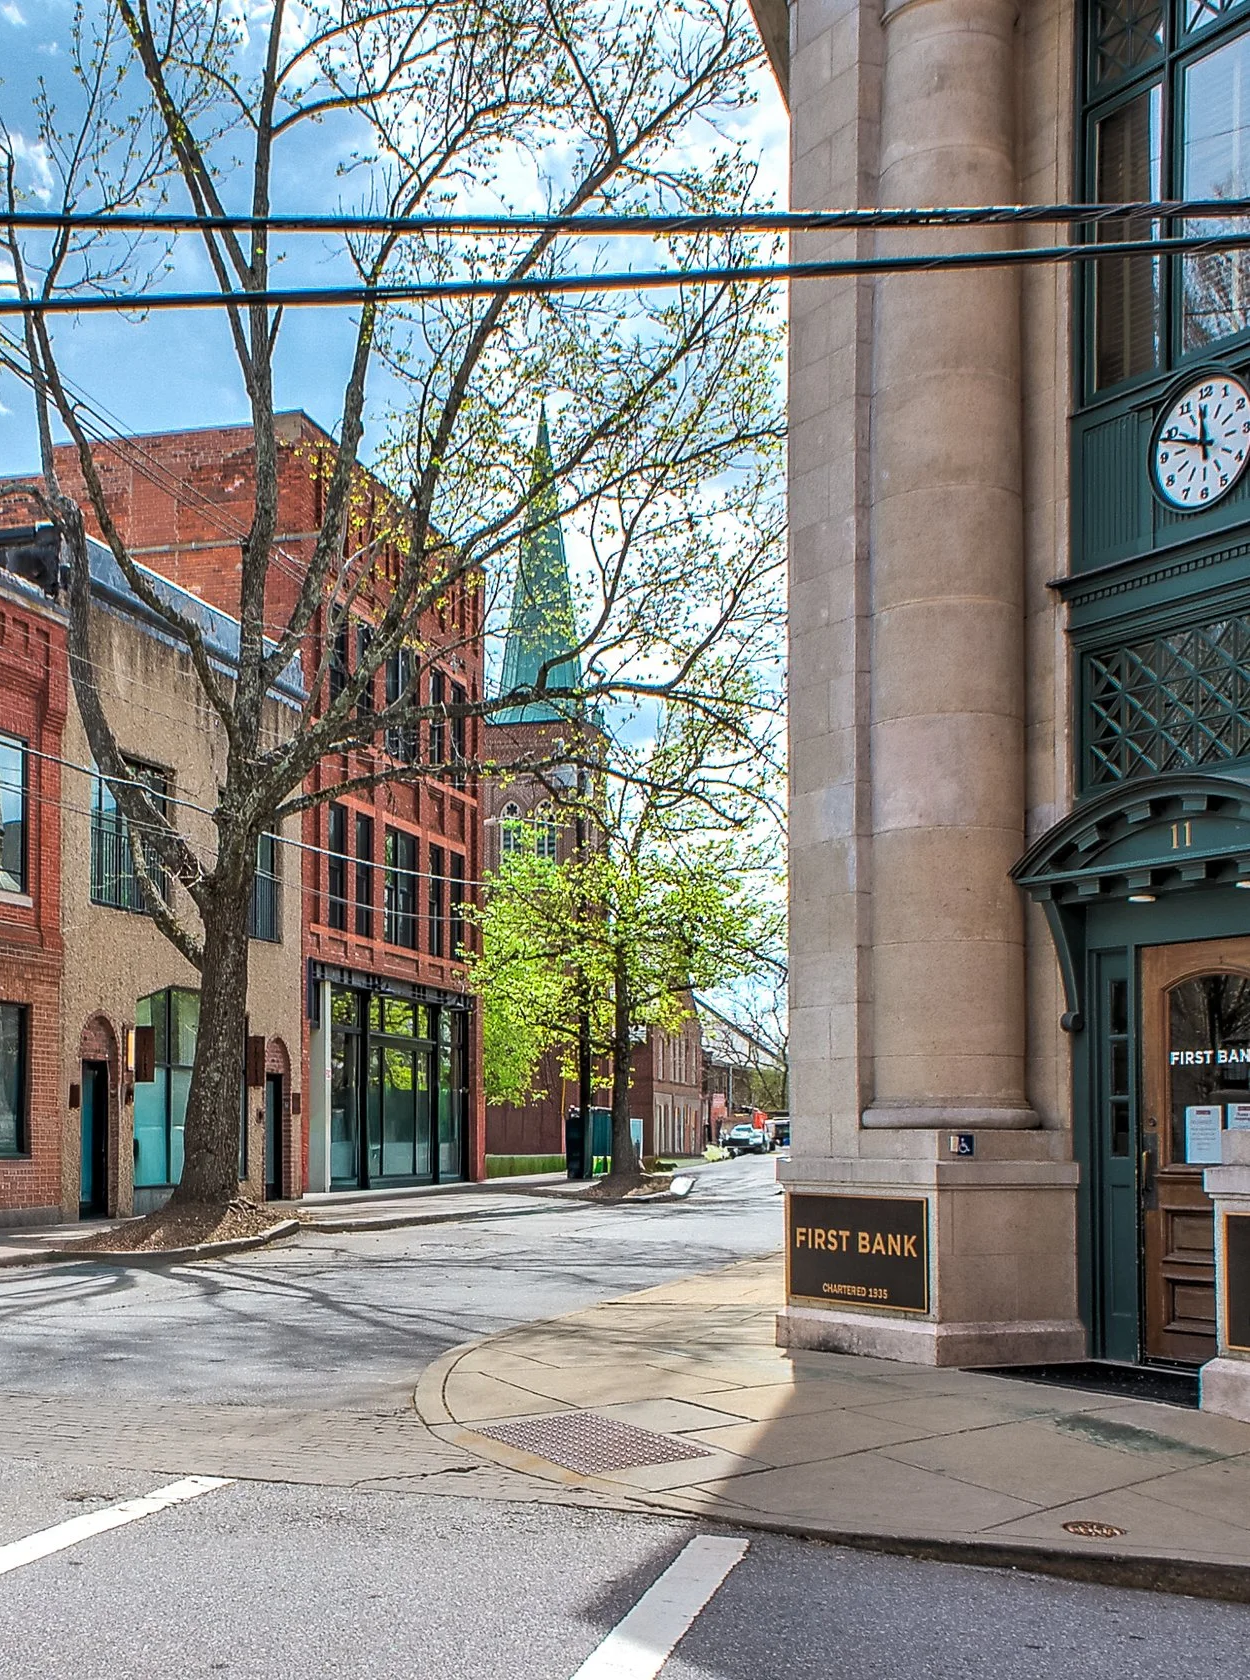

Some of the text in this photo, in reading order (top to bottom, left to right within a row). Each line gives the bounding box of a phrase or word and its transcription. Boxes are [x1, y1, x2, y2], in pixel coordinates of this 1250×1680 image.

[1199, 385, 1213, 399] 12
[1222, 385, 1229, 398] 1
[1180, 402, 1191, 416] 11
[1236, 397, 1245, 412] 2
[1166, 427, 1178, 439] 10
[1160, 452, 1169, 464] 9
[1235, 450, 1244, 462] 4
[1166, 475, 1175, 487] 8
[1220, 474, 1228, 487] 5
[1182, 487, 1191, 500] 7
[1201, 487, 1209, 499] 6
[1170, 820, 1192, 849] 11
[1170, 1051, 1214, 1065] FIRST
[796, 1227, 917, 1257] FIRST BANK
[822, 1282, 888, 1300] CHARTERED 1935
